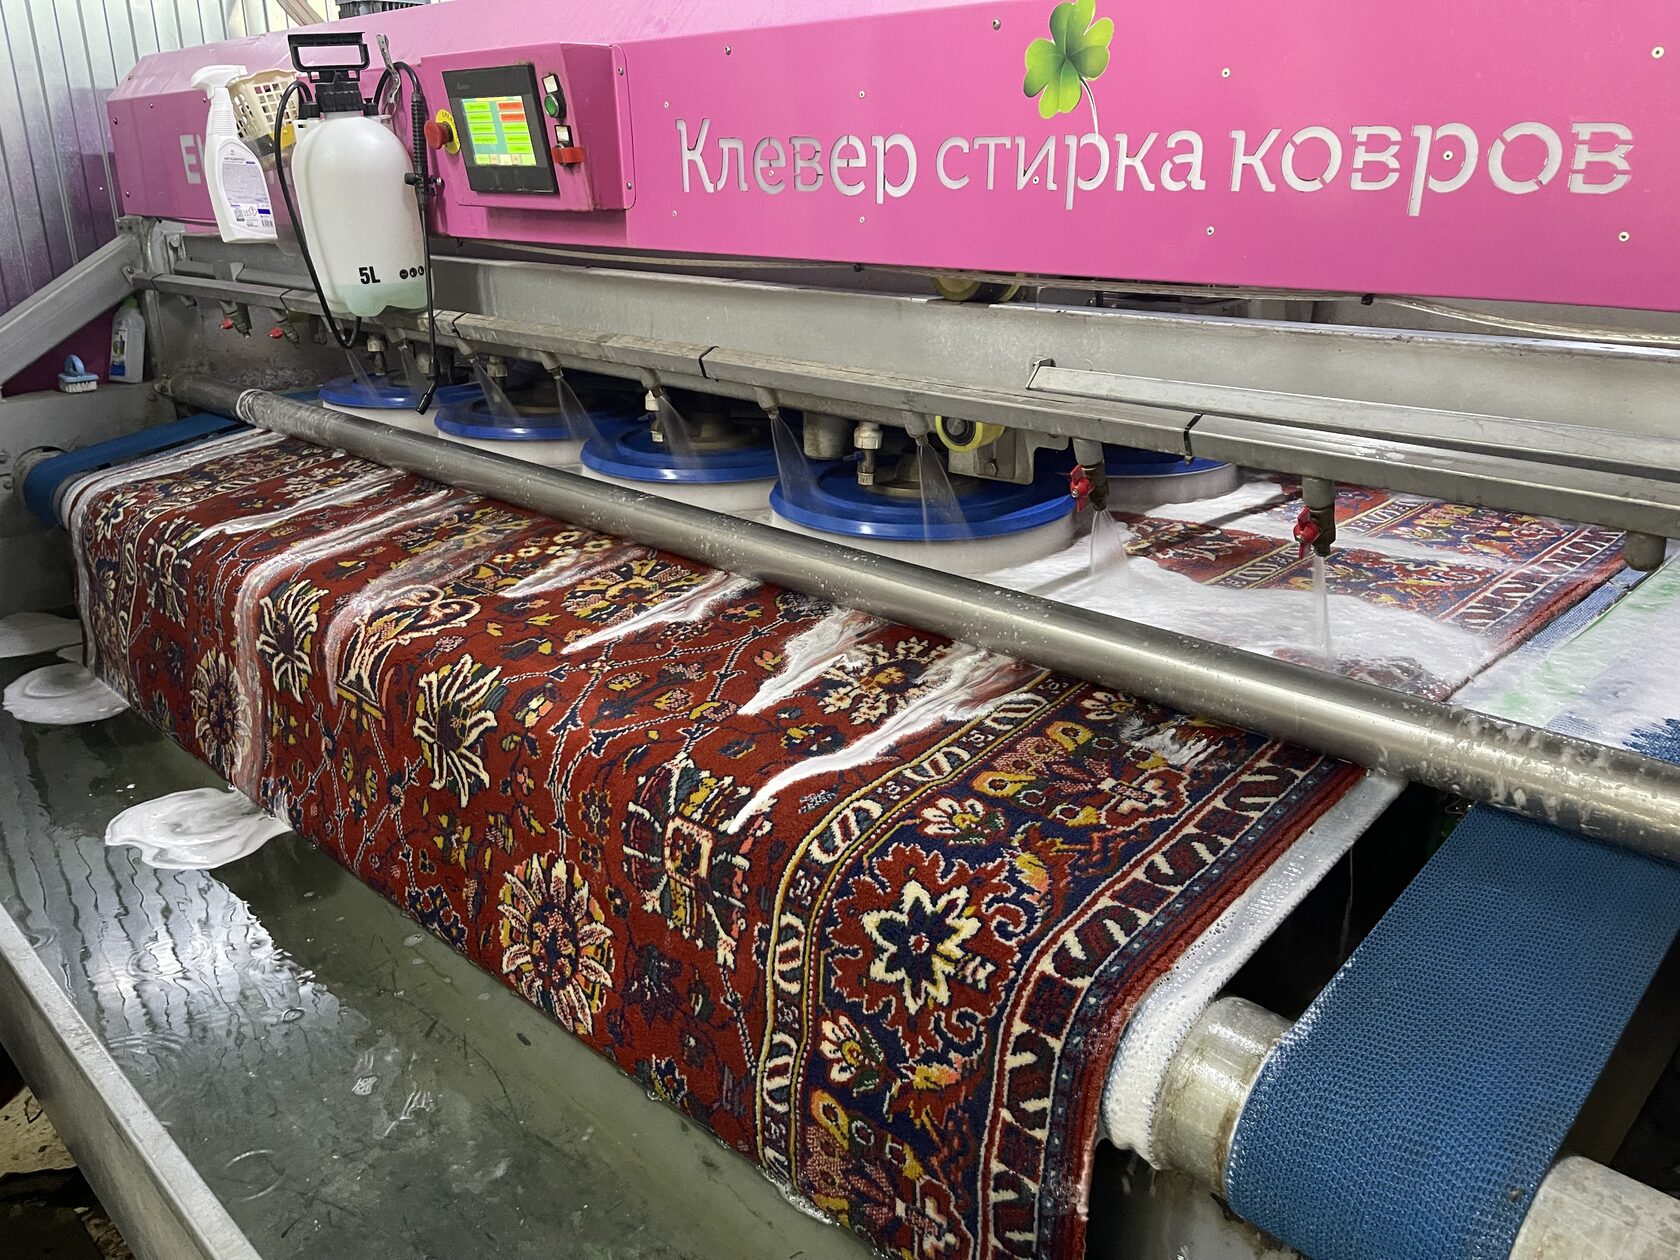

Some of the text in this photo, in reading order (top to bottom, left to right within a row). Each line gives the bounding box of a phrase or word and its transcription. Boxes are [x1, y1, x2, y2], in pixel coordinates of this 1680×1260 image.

[675, 118, 1635, 217] Клевер стирка ковров
[358, 266, 381, 285] 5L
